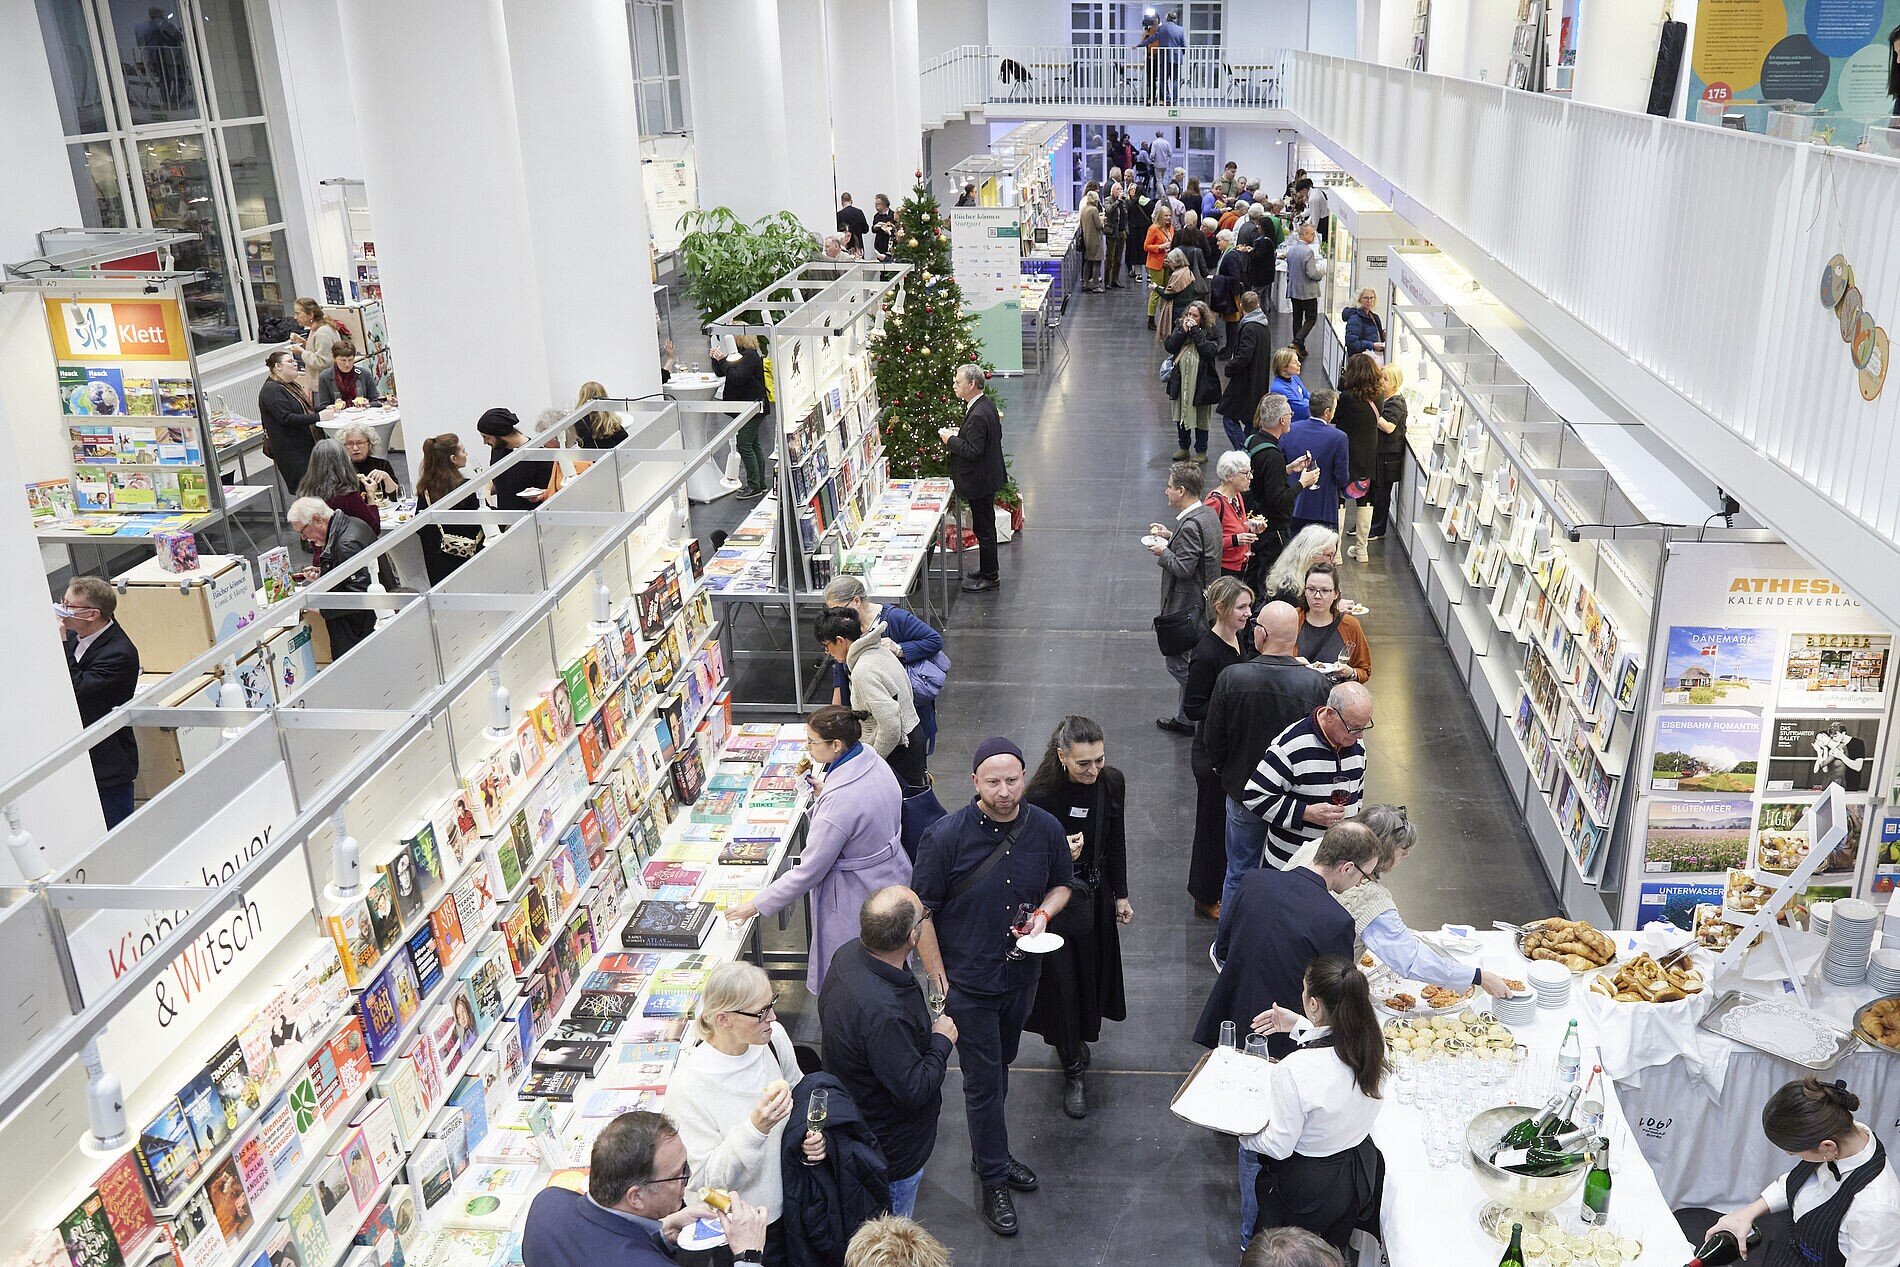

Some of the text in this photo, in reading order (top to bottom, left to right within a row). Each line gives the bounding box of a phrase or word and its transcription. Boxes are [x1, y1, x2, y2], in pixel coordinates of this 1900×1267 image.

[1708, 88, 1727, 99] 175
[119, 322, 165, 345] Klett
[211, 576, 246, 599] Bücher können
[1729, 578, 1845, 594] ATHESI
[1692, 634, 1754, 644] DÄNEMARK
[1806, 633, 1871, 648] BÜCHER
[1819, 694, 1875, 704] Buchhandlungen
[1661, 721, 1712, 730] EISENBAHN
[1714, 722, 1760, 731] ROMANTIK
[1672, 803, 1732, 812] BLÜTENMEER
[1765, 809, 1792, 826] TIGER
[412, 835, 435, 862] Pola
[458, 891, 474, 910] TERROR
[1659, 887, 1724, 895] UNTERWASSER
[459, 899, 474, 916] GEGEN
[460, 905, 475, 922] JUDEN
[156, 981, 178, 1027] &
[172, 901, 262, 1004] Witsch
[369, 989, 389, 1017] CRAZY
[372, 1001, 394, 1032] RICH
[209, 1047, 243, 1082] FINSTERES
[221, 1066, 240, 1089] HERZ
[542, 1076, 551, 1085] THE
[546, 1071, 562, 1092] PARENTS
[233, 1133, 261, 1163] DAS KANN
[268, 1125, 296, 1158] gewusst
[243, 1149, 258, 1167] DOCH
[243, 1156, 265, 1182] JEMAND
[246, 1166, 269, 1193] ANDERES
[249, 1177, 271, 1203] MACHEN!
[68, 1214, 96, 1242] RULE
[300, 1220, 322, 1250] AUS
[303, 1232, 326, 1263] DEM
